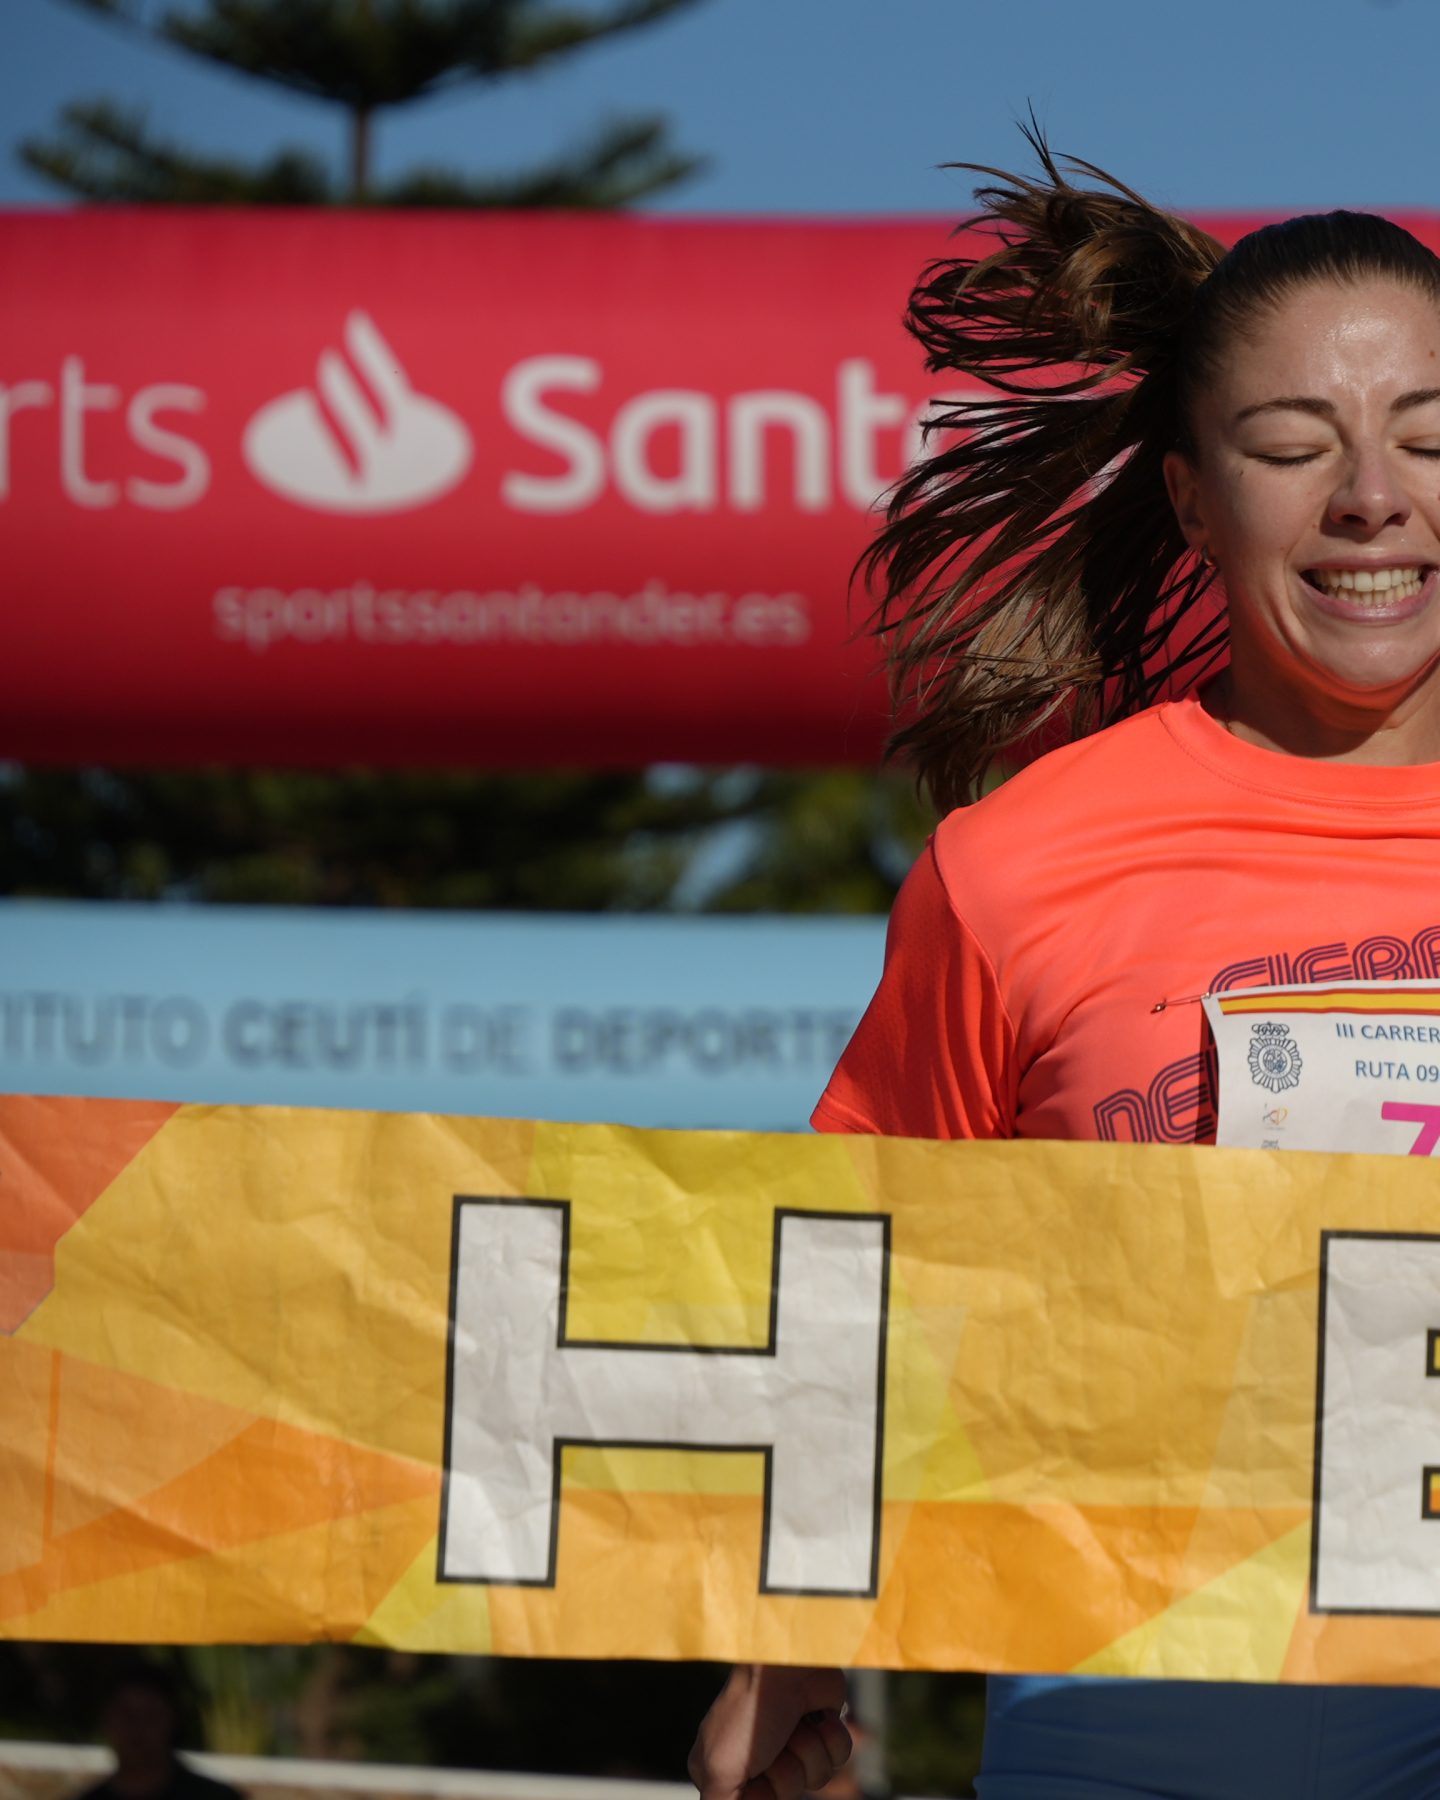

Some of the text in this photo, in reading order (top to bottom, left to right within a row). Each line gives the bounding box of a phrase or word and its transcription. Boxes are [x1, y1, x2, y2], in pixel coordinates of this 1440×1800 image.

[212, 580, 812, 654] sportssantander.es
[440, 1003, 540, 1077] DE
[1335, 1022, 1355, 1039] III
[1355, 1060, 1411, 1081] RUTA
